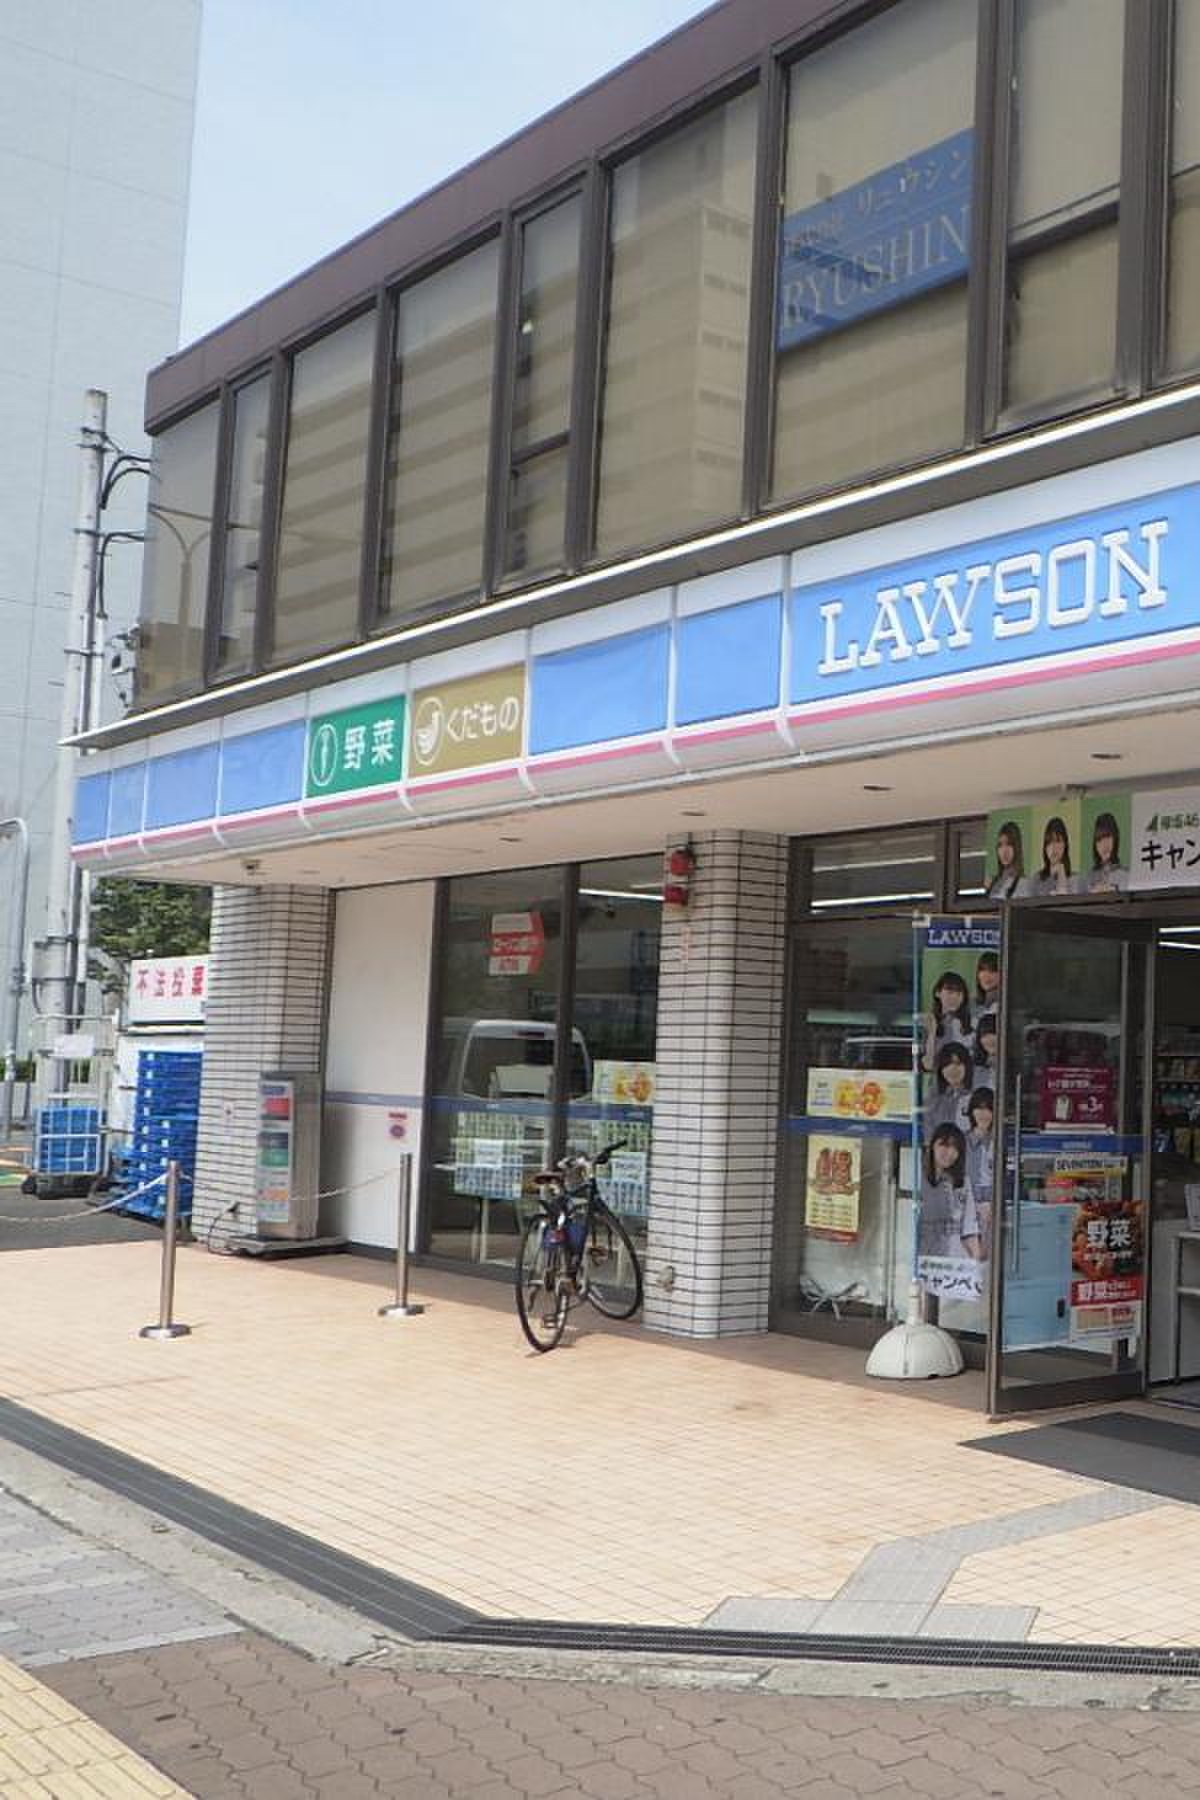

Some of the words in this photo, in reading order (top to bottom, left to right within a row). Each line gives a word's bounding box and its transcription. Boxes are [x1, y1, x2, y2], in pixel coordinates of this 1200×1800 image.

[783, 205, 971, 330] RYUSHIN
[817, 516, 1169, 675] LAWSON
[343, 718, 395, 770] 野菜
[447, 697, 519, 742] くだもの
[1087, 1219, 1132, 1248] 野菜
